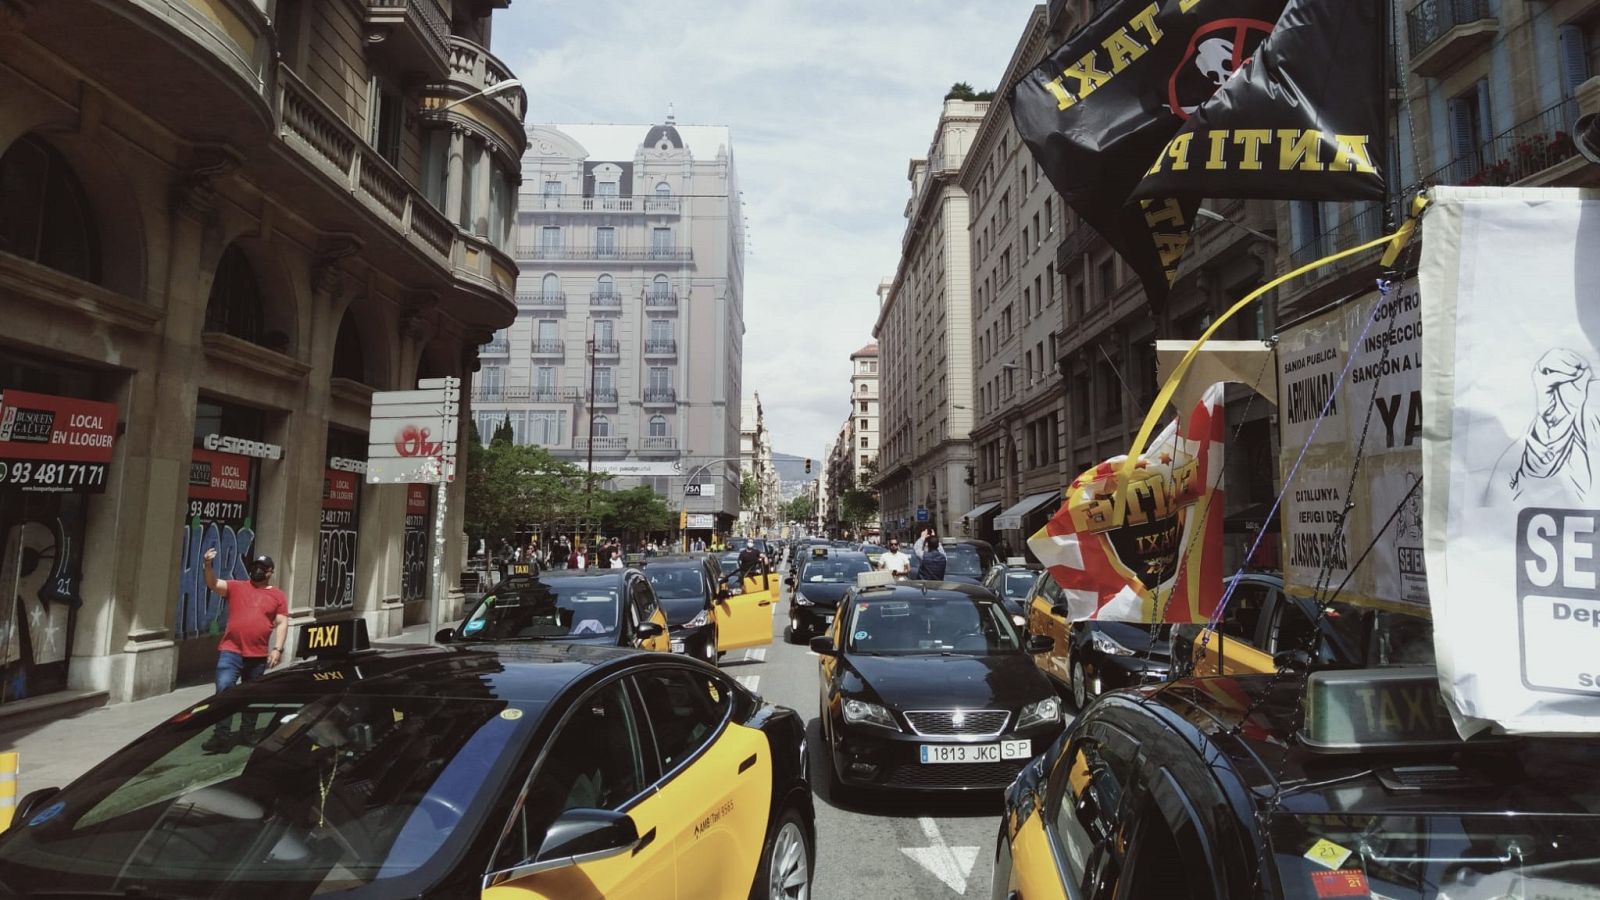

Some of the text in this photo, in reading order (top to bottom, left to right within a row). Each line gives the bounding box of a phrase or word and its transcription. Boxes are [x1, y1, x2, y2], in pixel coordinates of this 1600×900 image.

[1374, 292, 1422, 322] CONTRO
[70, 414, 104, 430] LOCAL
[52, 430, 68, 444] EN
[69, 432, 112, 448] LLOGUER
[10, 462, 104, 485] 93 481 71 71
[221, 466, 240, 477] LOCAL
[191, 501, 242, 518] 93 481 71 71
[514, 564, 529, 574] TAXI
[308, 625, 339, 648] TAXI
[1354, 687, 1442, 733] TAX
[933, 742, 1028, 761] 1813 JKC SP
[1320, 847, 1336, 857] 21
[1348, 879, 1362, 888] 21
